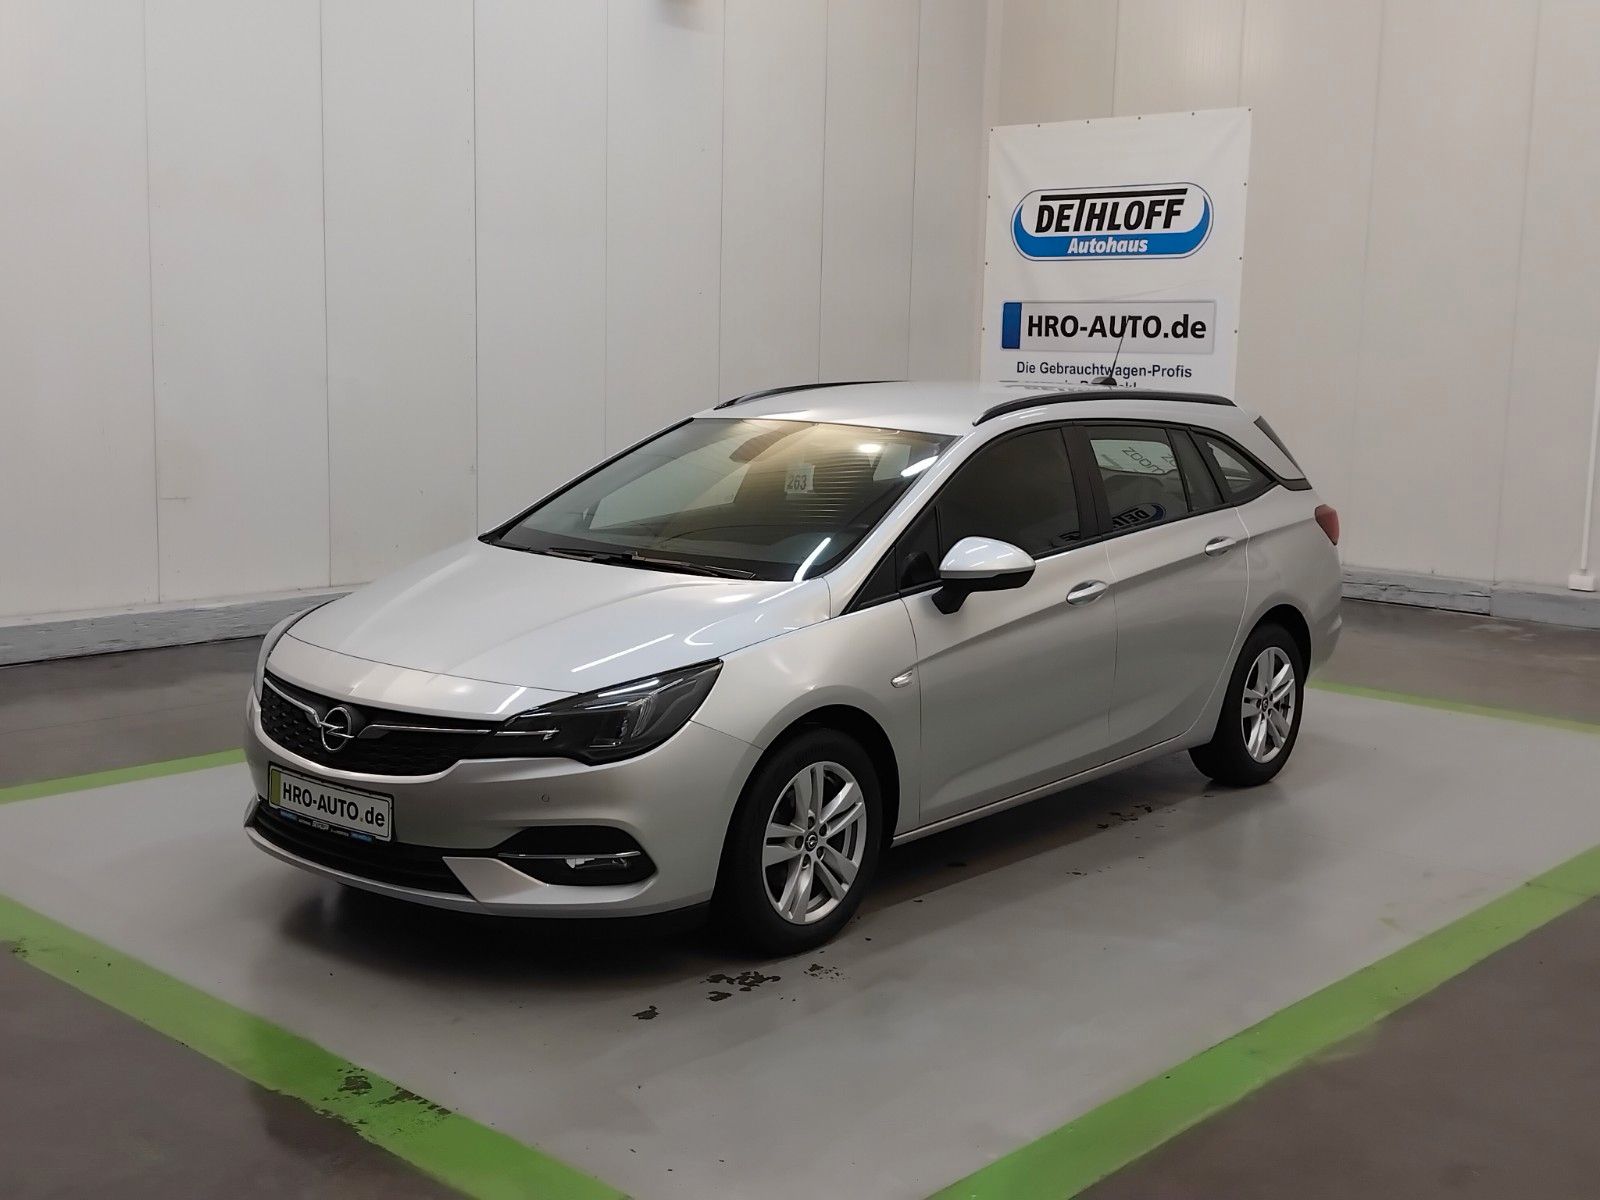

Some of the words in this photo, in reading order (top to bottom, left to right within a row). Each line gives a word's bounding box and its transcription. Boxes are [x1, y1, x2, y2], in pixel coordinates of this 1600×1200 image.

[1035, 188, 1188, 233] DETHLOFF
[1067, 236, 1149, 255] Autohaus
[1027, 314, 1207, 339] HRO-AUTO.de
[1016, 361, 1036, 375] Die
[1039, 362, 1193, 379] Gebrauchtwagen-Profis
[787, 474, 808, 491] 263
[282, 781, 385, 828] HRO-AUTO.de
